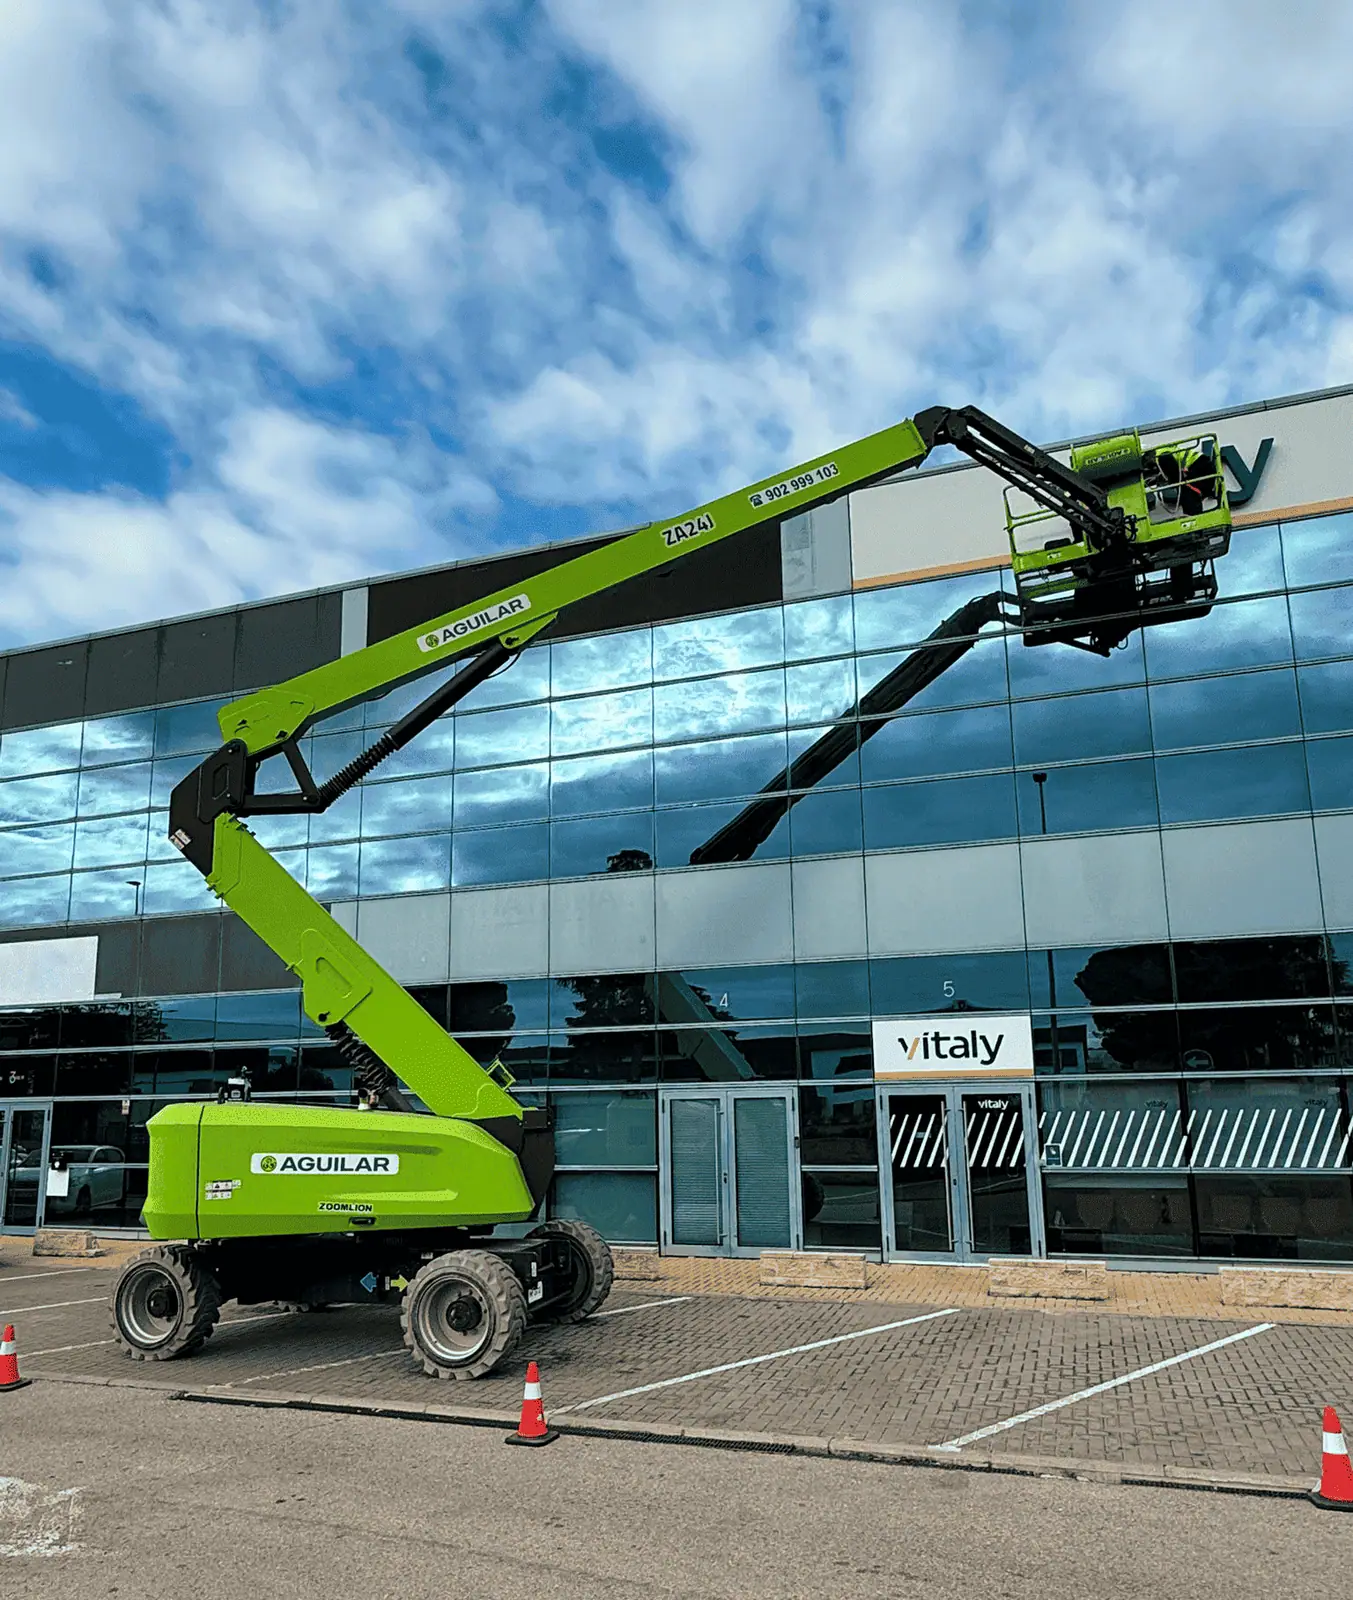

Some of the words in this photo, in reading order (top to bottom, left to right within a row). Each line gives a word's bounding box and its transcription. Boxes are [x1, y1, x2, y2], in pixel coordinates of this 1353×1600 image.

[765, 483, 790, 502] 902
[790, 473, 814, 491] 999
[815, 463, 839, 481] 103
[662, 514, 714, 546] ZA24J
[442, 599, 524, 642] AGUILAR
[943, 980, 955, 997] 5
[719, 992, 728, 1007] 4
[897, 1030, 1004, 1065] vitaly
[977, 1099, 1009, 1111] vitaly
[279, 1156, 390, 1172] AGUILAR
[318, 1202, 373, 1212] ZOOMLION
